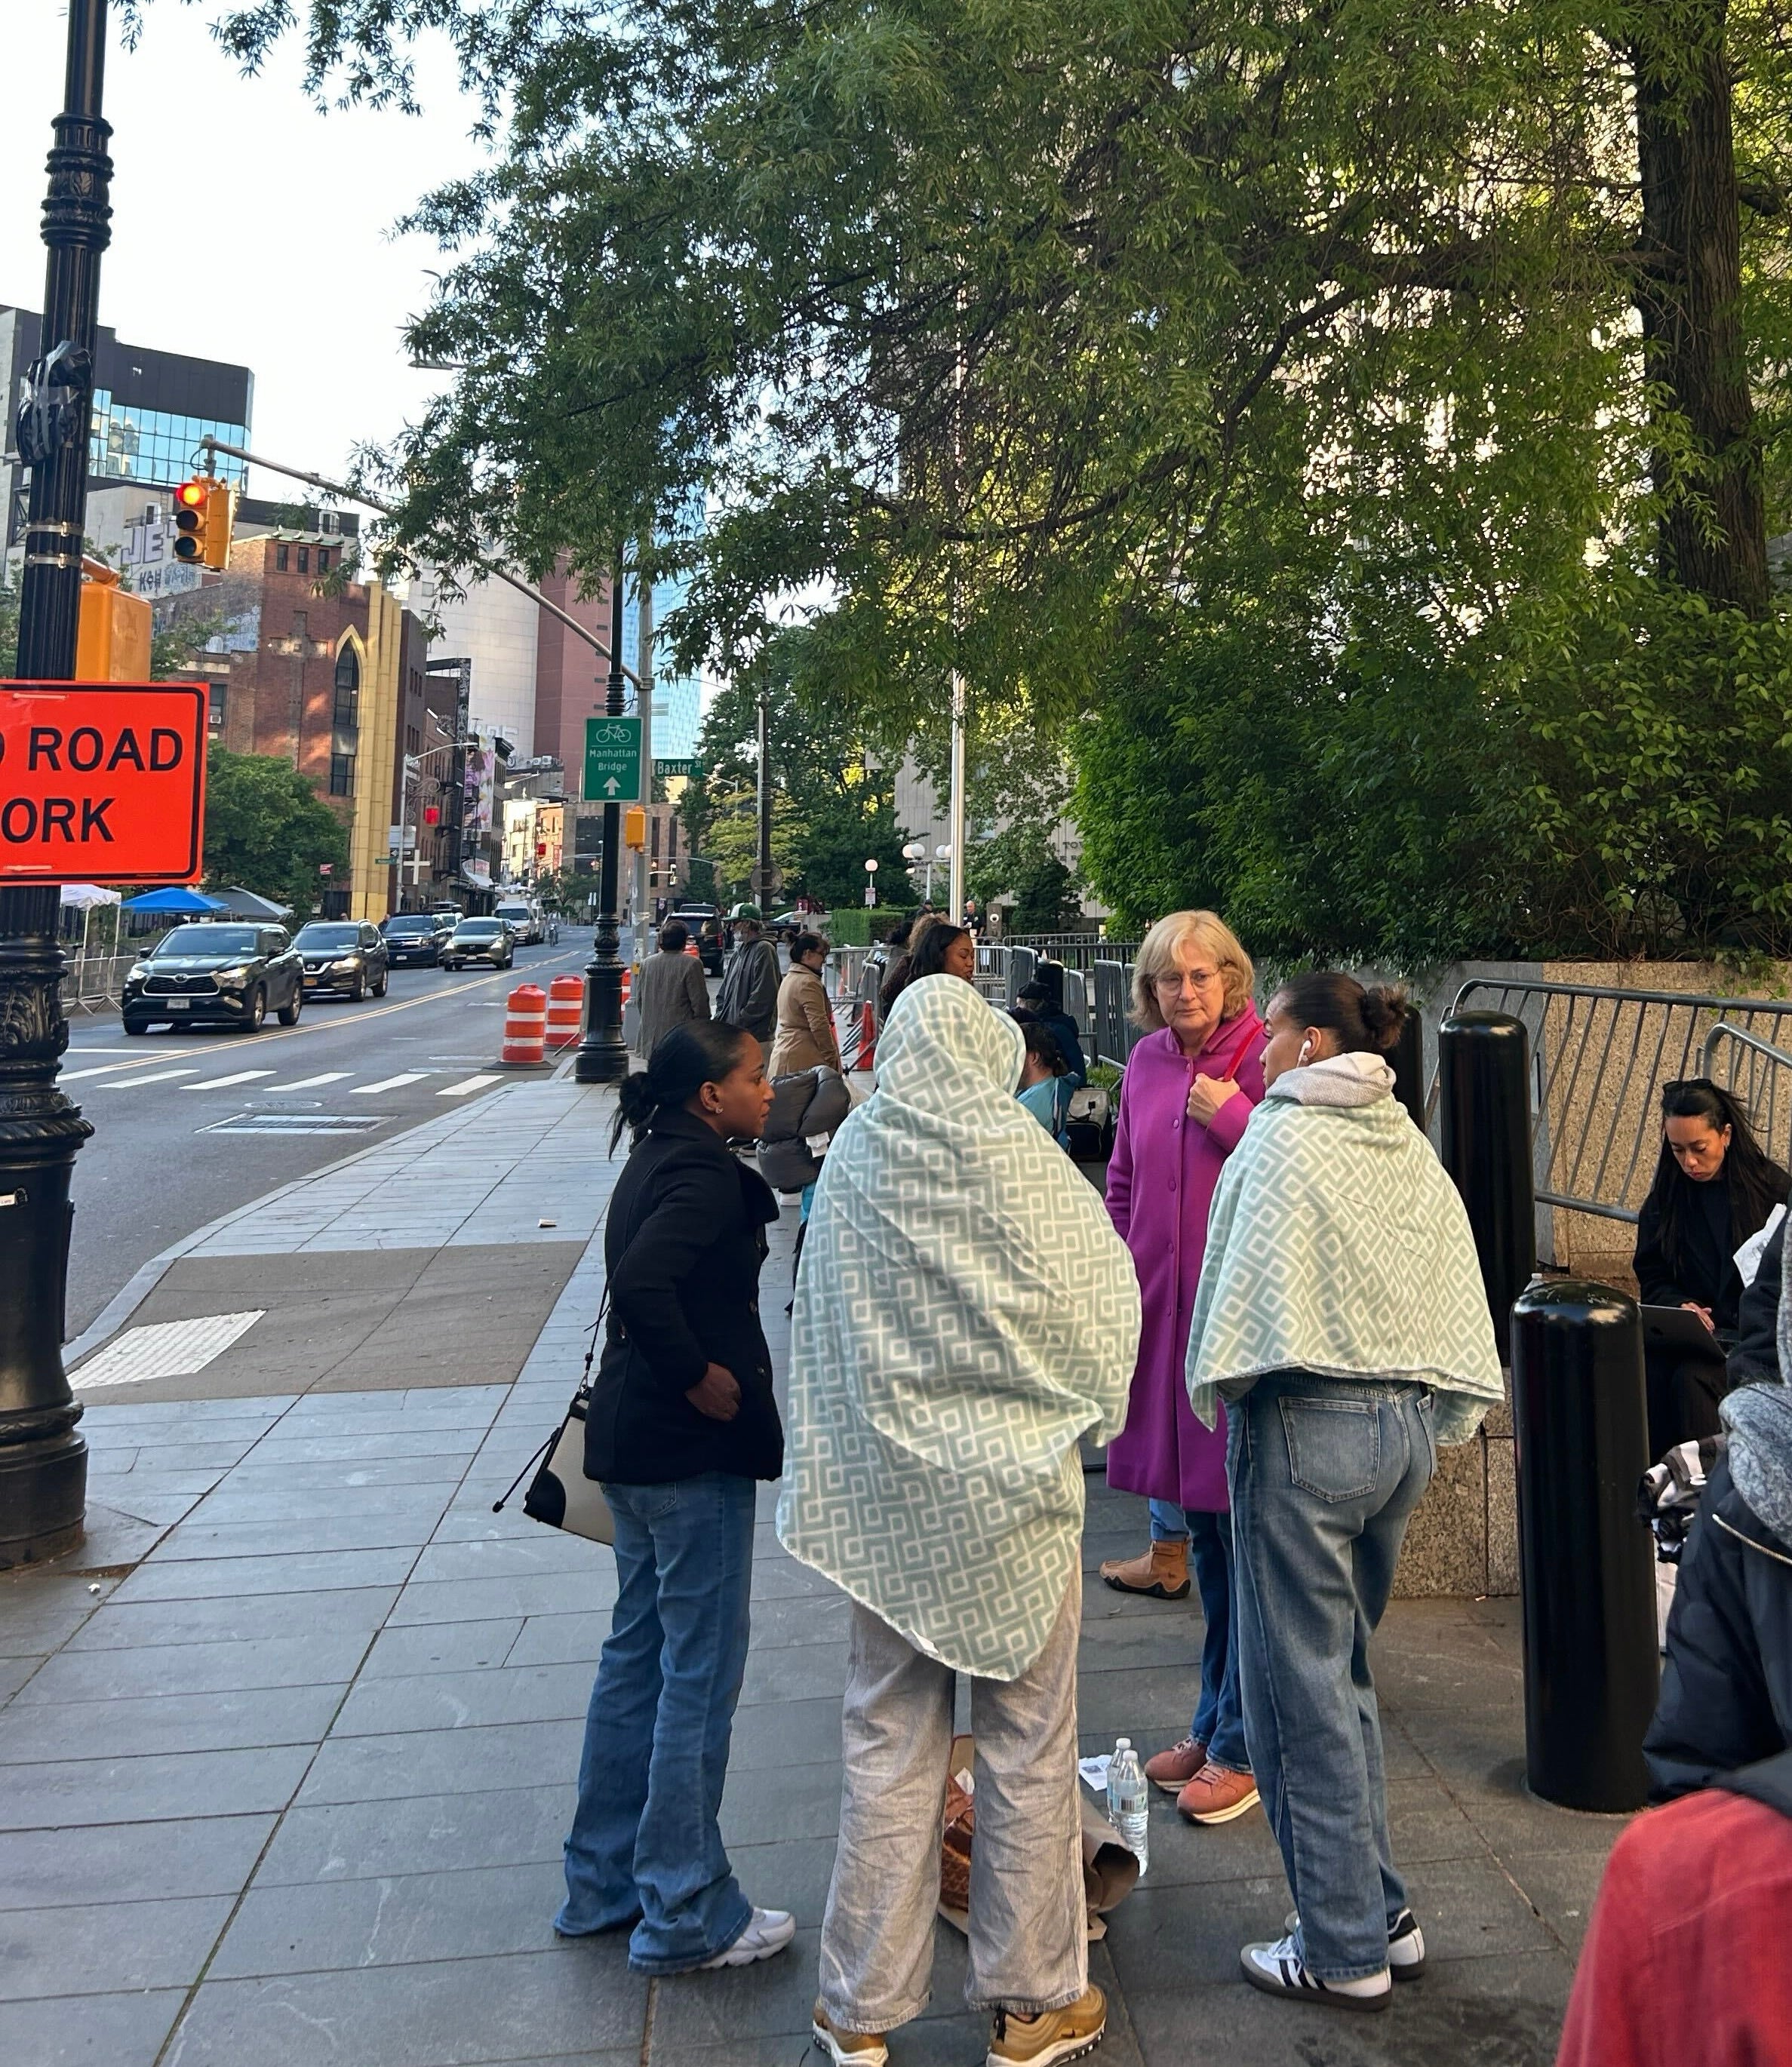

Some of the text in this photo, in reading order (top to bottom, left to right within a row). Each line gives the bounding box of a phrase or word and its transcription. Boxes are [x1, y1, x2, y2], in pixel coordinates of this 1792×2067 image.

[28, 726, 183, 772] ROAD
[589, 749, 637, 758] Manhattan
[598, 762, 628, 772] Bridge
[657, 761, 692, 775] Baxter
[1, 797, 115, 843] ORK
